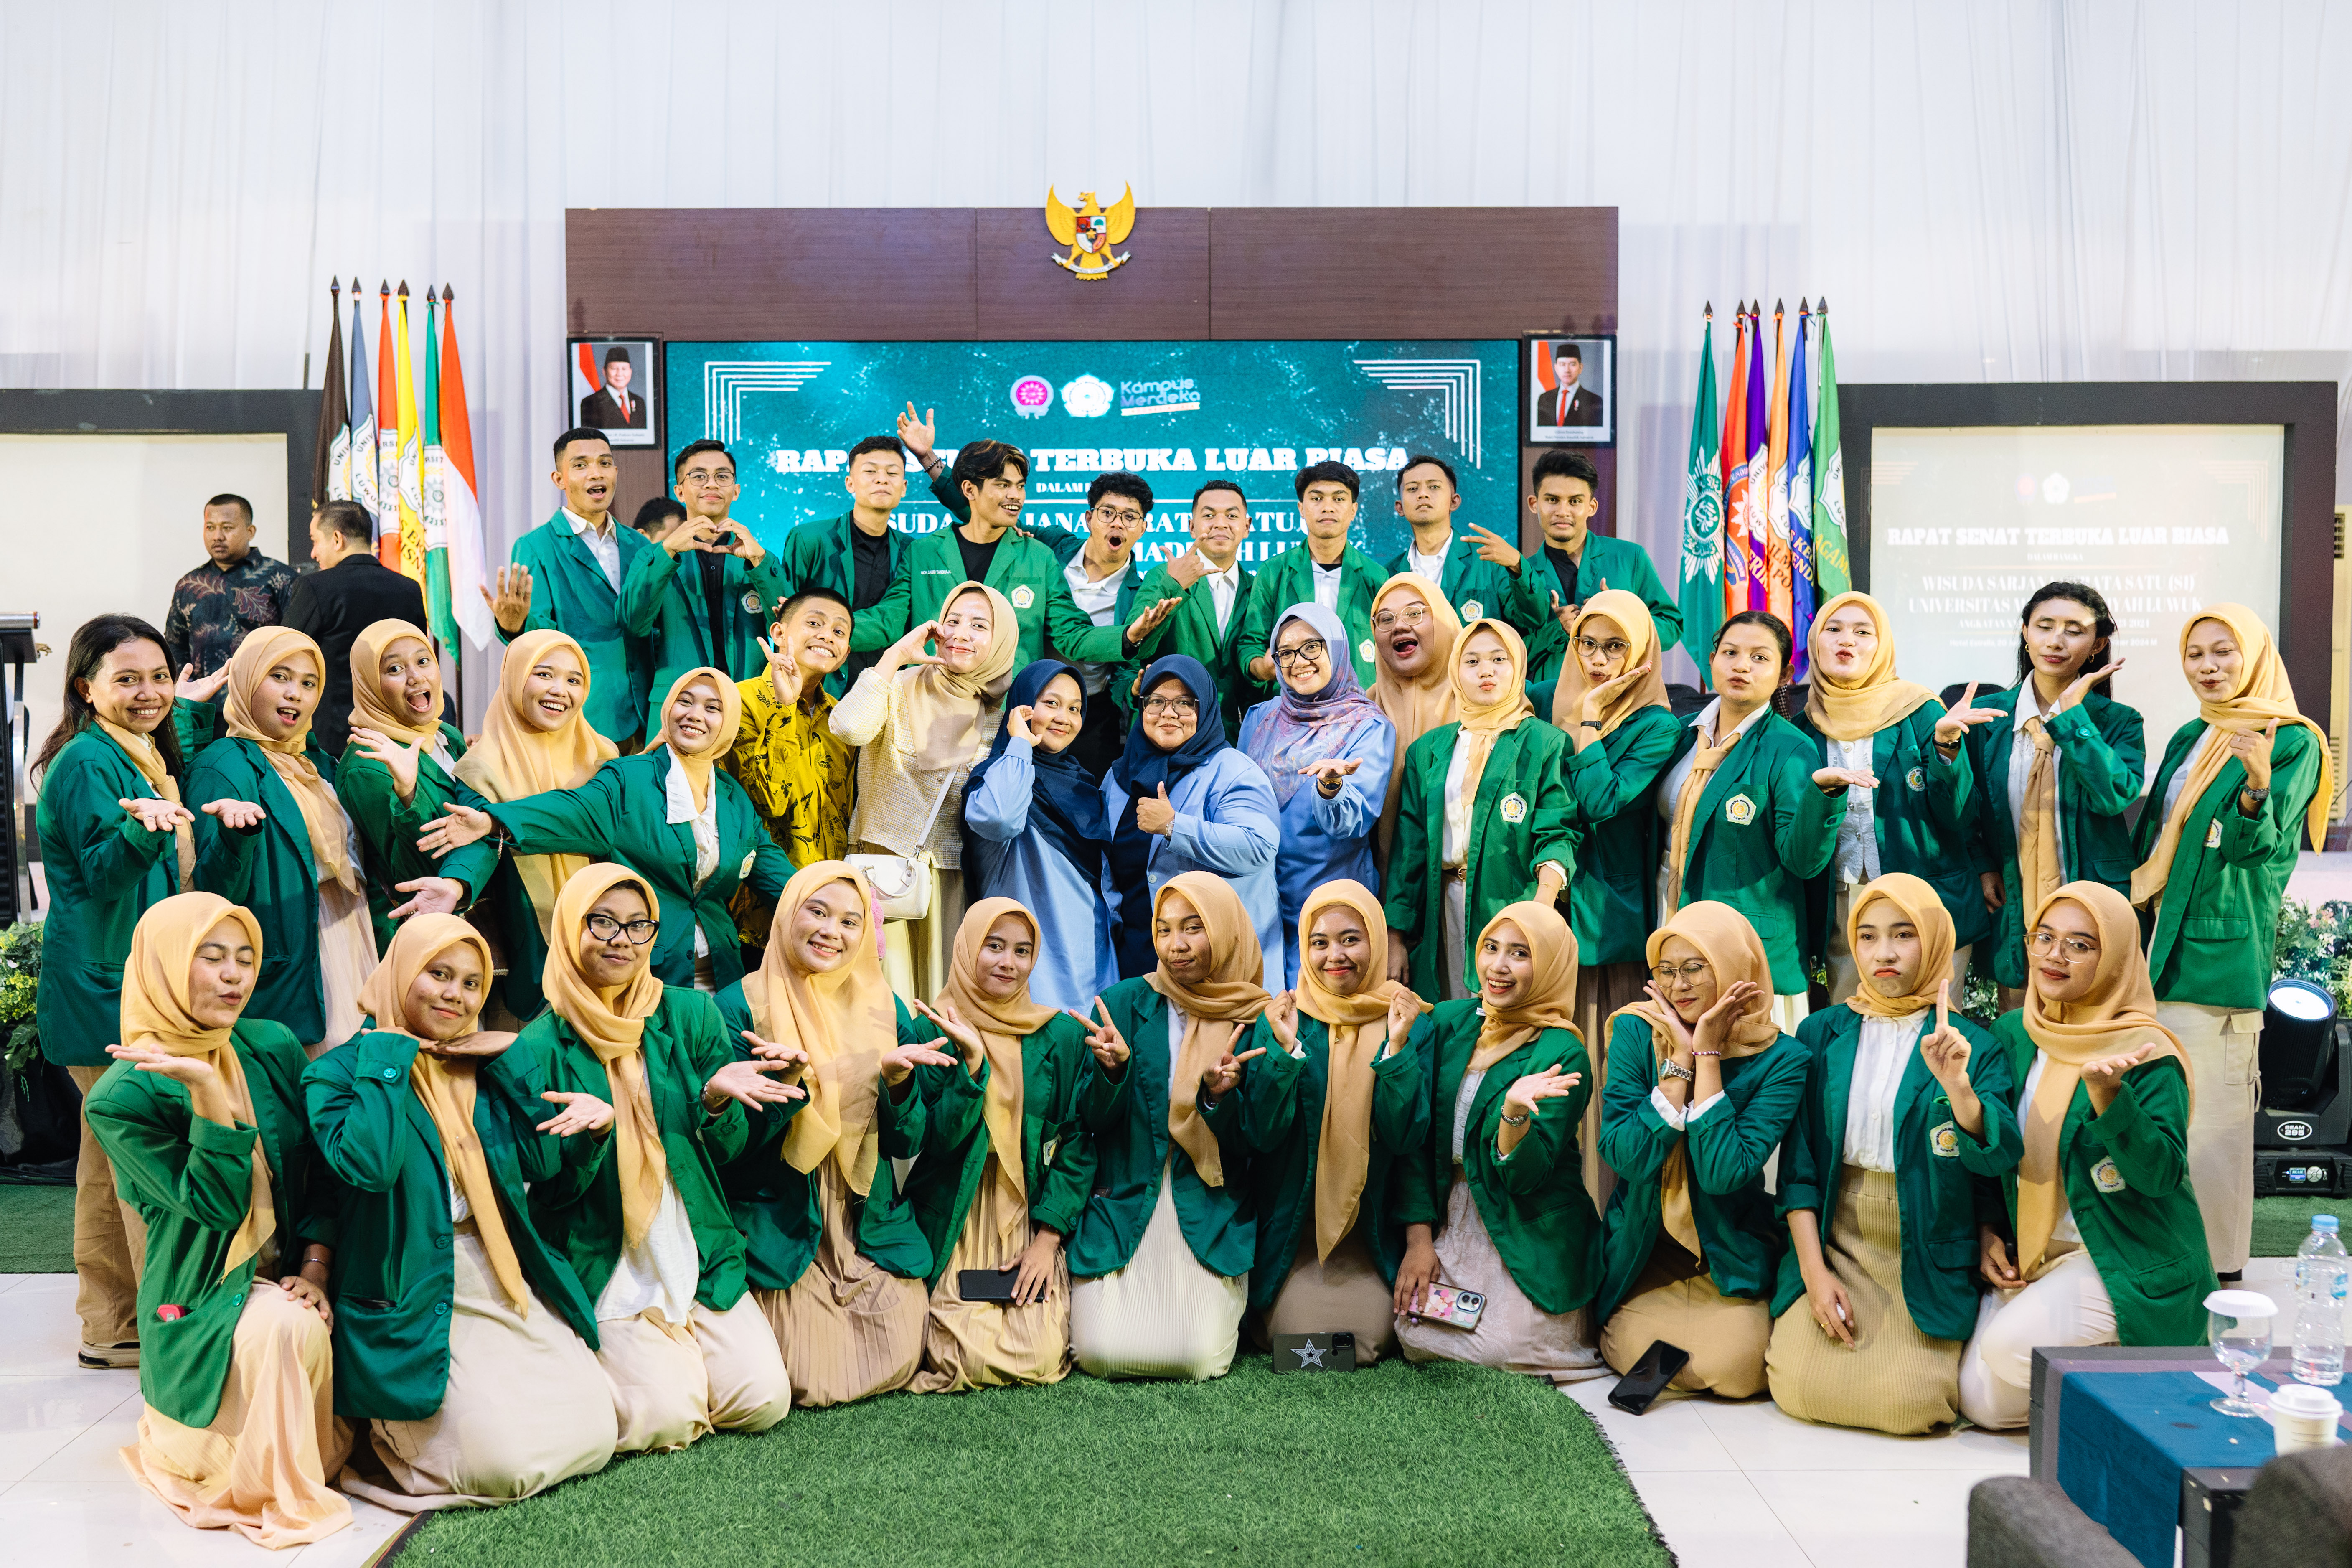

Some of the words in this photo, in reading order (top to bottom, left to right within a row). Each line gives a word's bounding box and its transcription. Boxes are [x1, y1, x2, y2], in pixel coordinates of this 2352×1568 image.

[1120, 378, 1194, 395] Kampus
[1120, 389, 1201, 407] Merdeka
[776, 449, 849, 473] RAP
[1030, 448, 1197, 472] TERBUKA
[1204, 447, 1298, 471] LUAR
[1036, 482, 1083, 493] DALAM
[887, 513, 953, 534] SUDA
[1887, 527, 1952, 546] RAPAT
[1956, 527, 2020, 546] SENAT
[2024, 526, 2114, 546] TERBUKA
[2118, 526, 2168, 545] LUAR
[2172, 526, 2229, 545] BIASA
[1921, 575, 1984, 592] WISUDA
[2124, 574, 2166, 591] SATU
[1908, 597, 2010, 613] UNIVERSITAS
[2146, 596, 2203, 613] LUWUK
